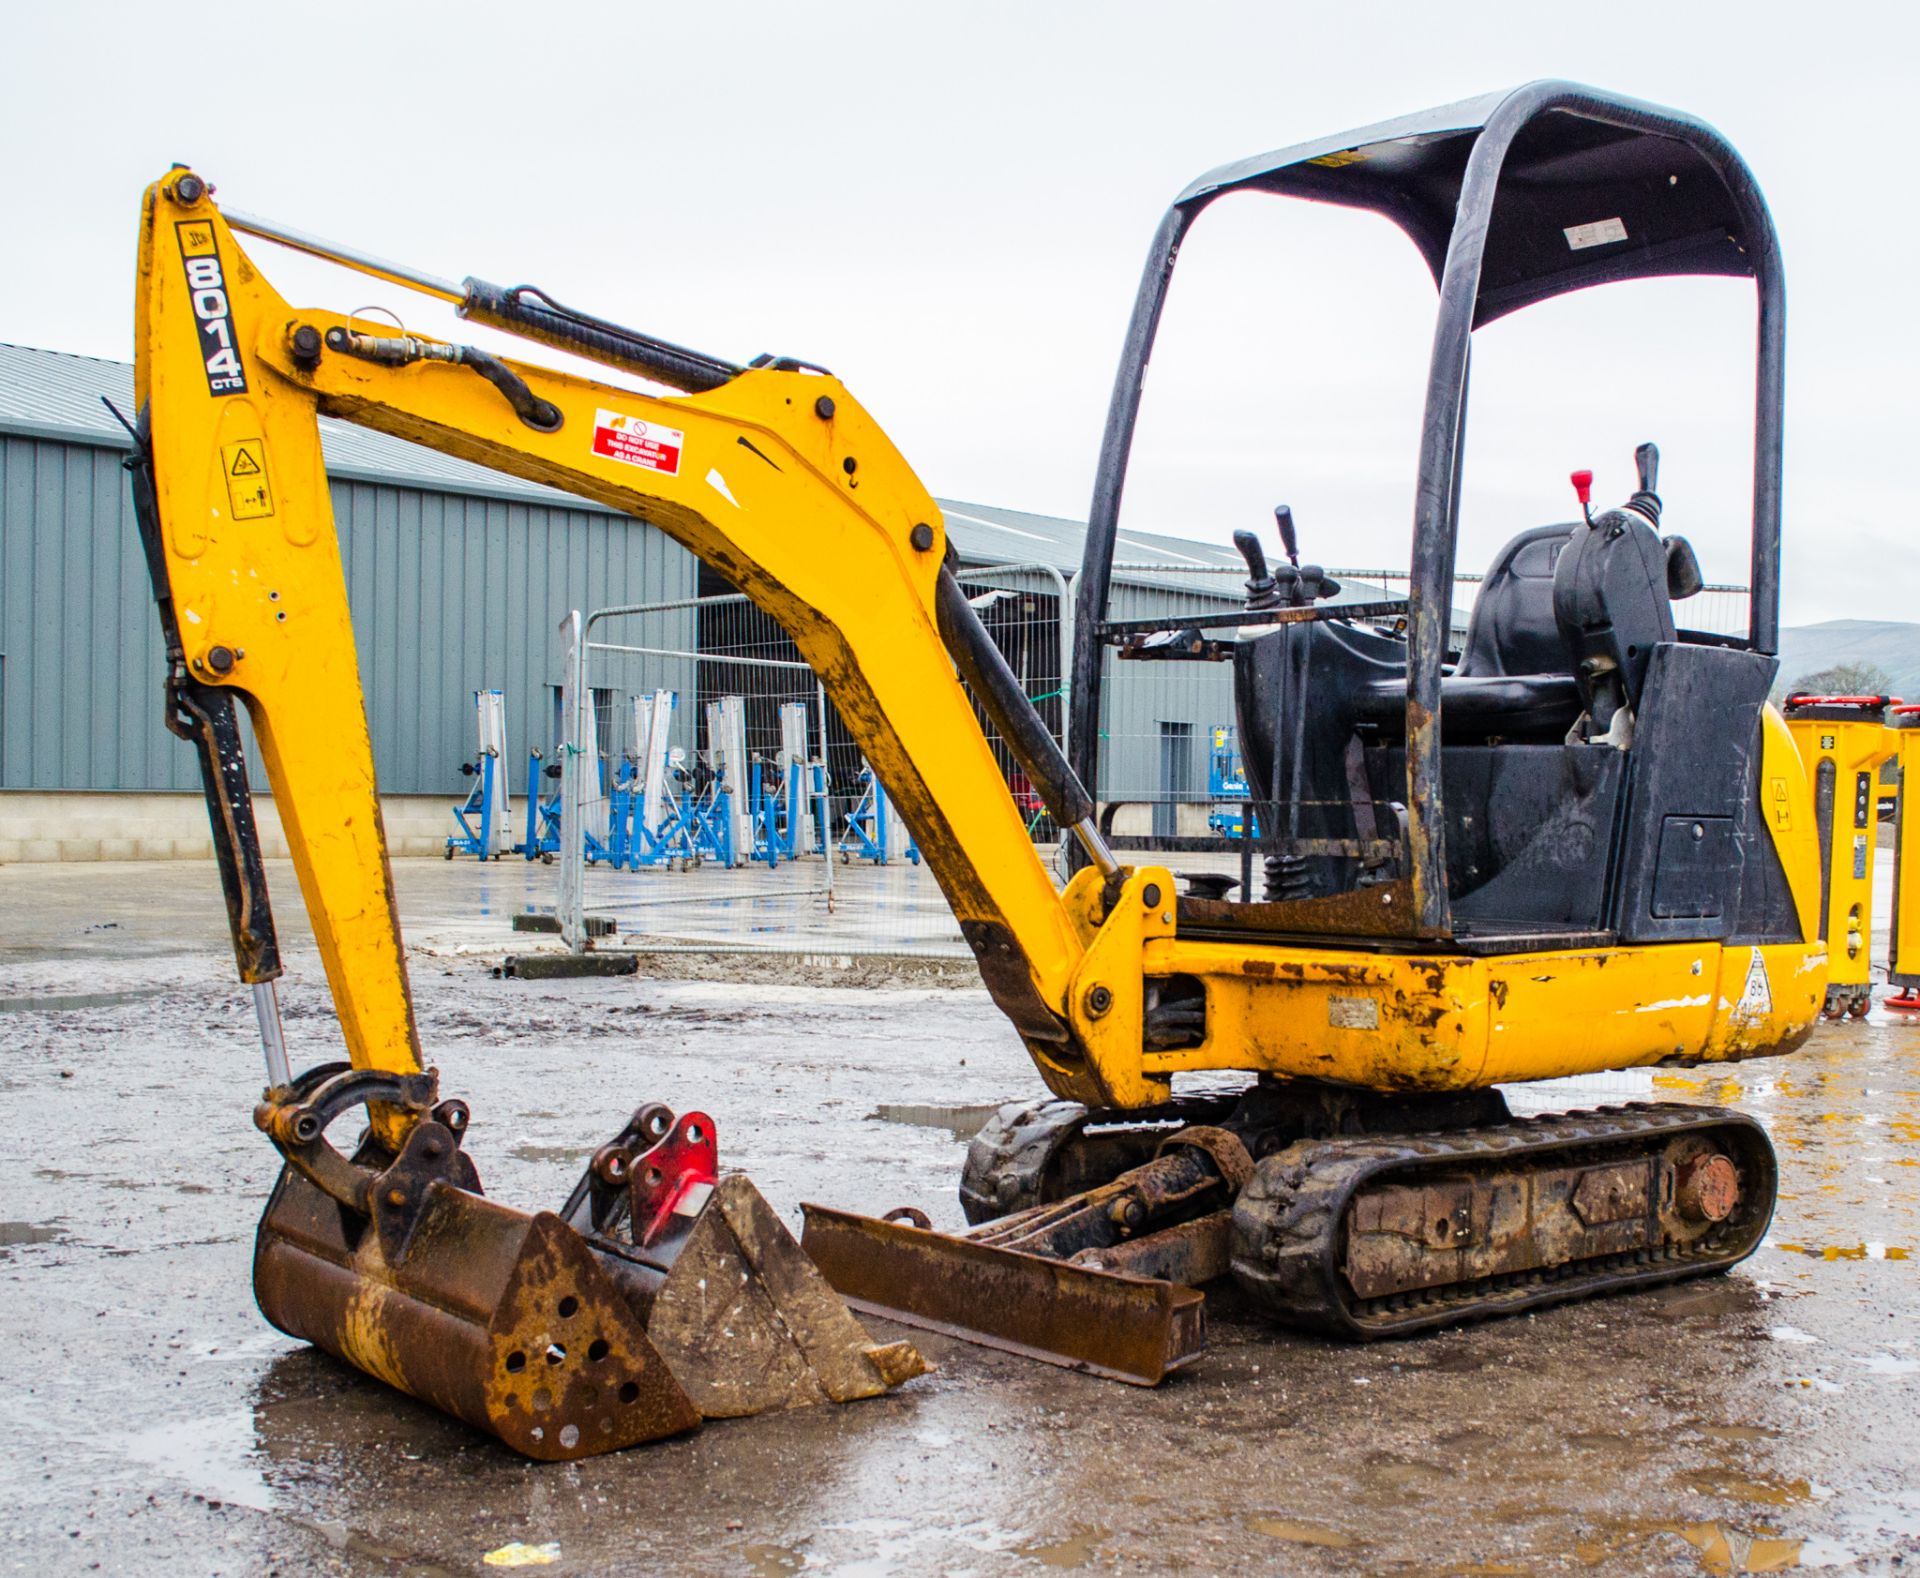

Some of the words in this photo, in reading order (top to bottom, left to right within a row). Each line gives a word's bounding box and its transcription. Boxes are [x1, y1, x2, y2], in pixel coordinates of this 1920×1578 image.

[189, 231, 209, 247] JCB
[186, 258, 242, 377] 8014
[210, 377, 244, 390] CTS
[607, 438, 624, 449] THIS
[624, 443, 667, 462] EXCAVATOR
[616, 432, 628, 442] DO
[628, 435, 644, 446] NOT
[644, 439, 660, 451] USE
[613, 450, 625, 460] AS
[625, 453, 631, 461] A
[631, 455, 657, 468] CRANE
[1222, 781, 1243, 790] Genie
